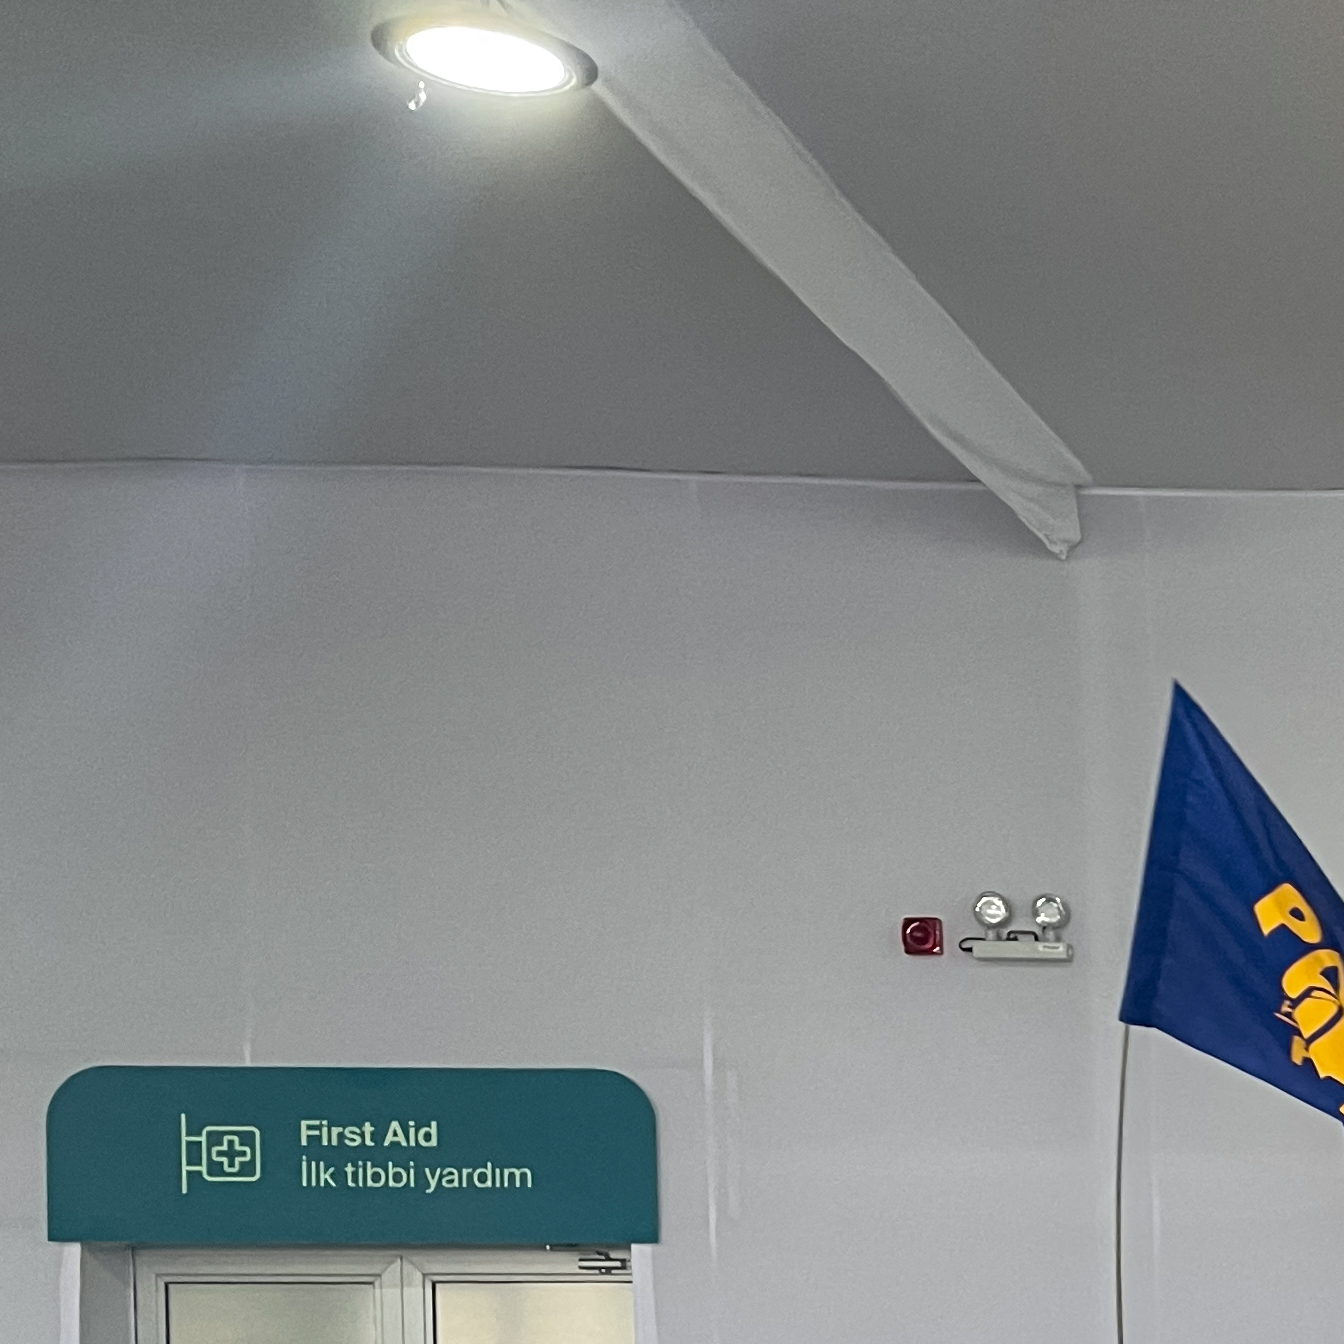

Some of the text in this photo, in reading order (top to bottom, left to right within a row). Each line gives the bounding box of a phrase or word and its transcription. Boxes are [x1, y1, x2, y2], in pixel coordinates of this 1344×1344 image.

[300, 1120, 438, 1147] First Aid
[301, 1155, 533, 1193] İlk tibbi yardım
